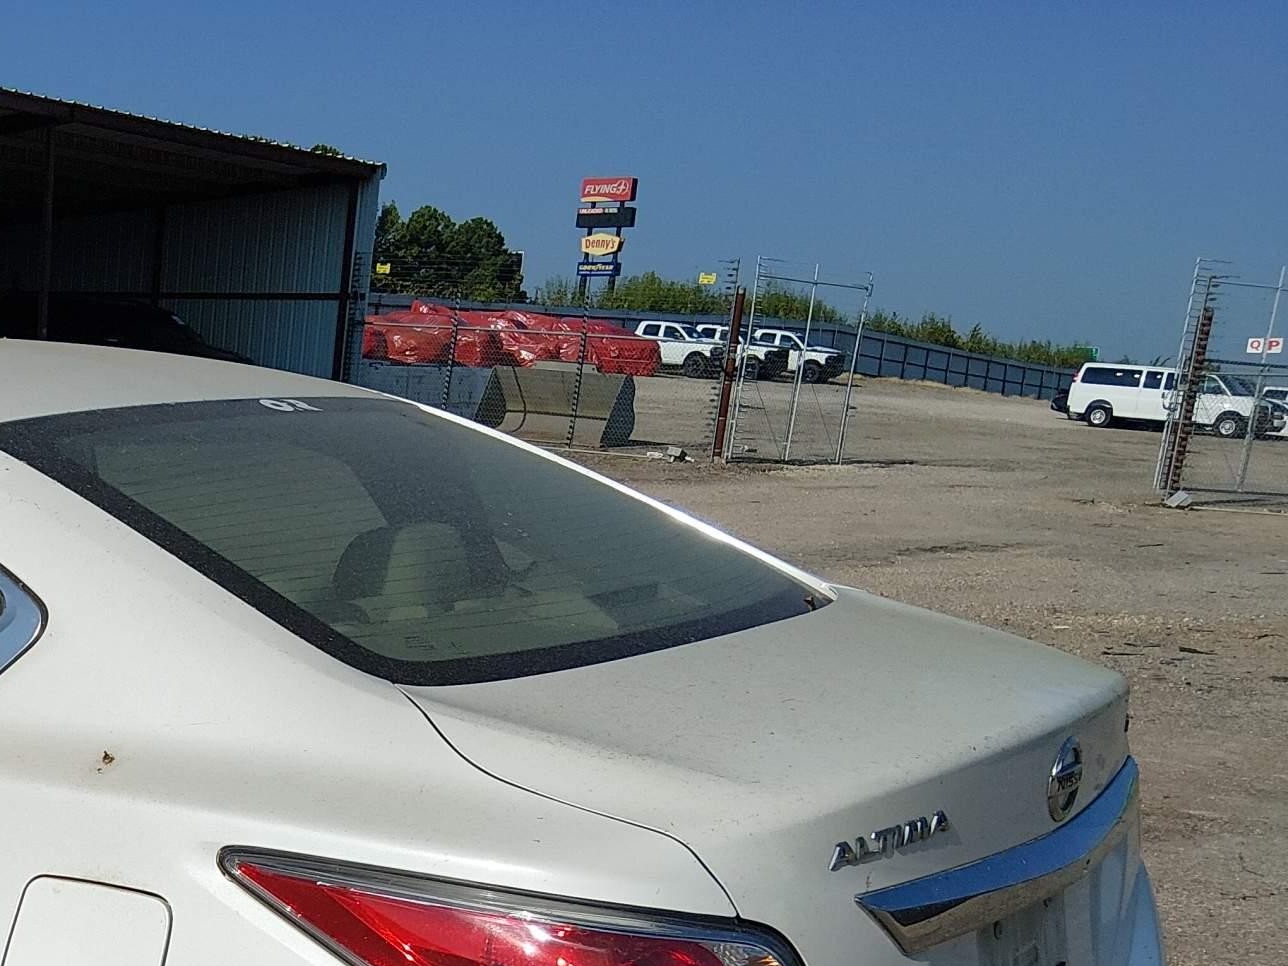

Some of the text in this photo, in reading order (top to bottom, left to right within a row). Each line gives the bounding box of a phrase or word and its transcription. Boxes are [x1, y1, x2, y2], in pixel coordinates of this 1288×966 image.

[584, 184, 617, 194] FLYING
[585, 239, 616, 250] Denny's
[828, 809, 951, 872] ALTIMA
